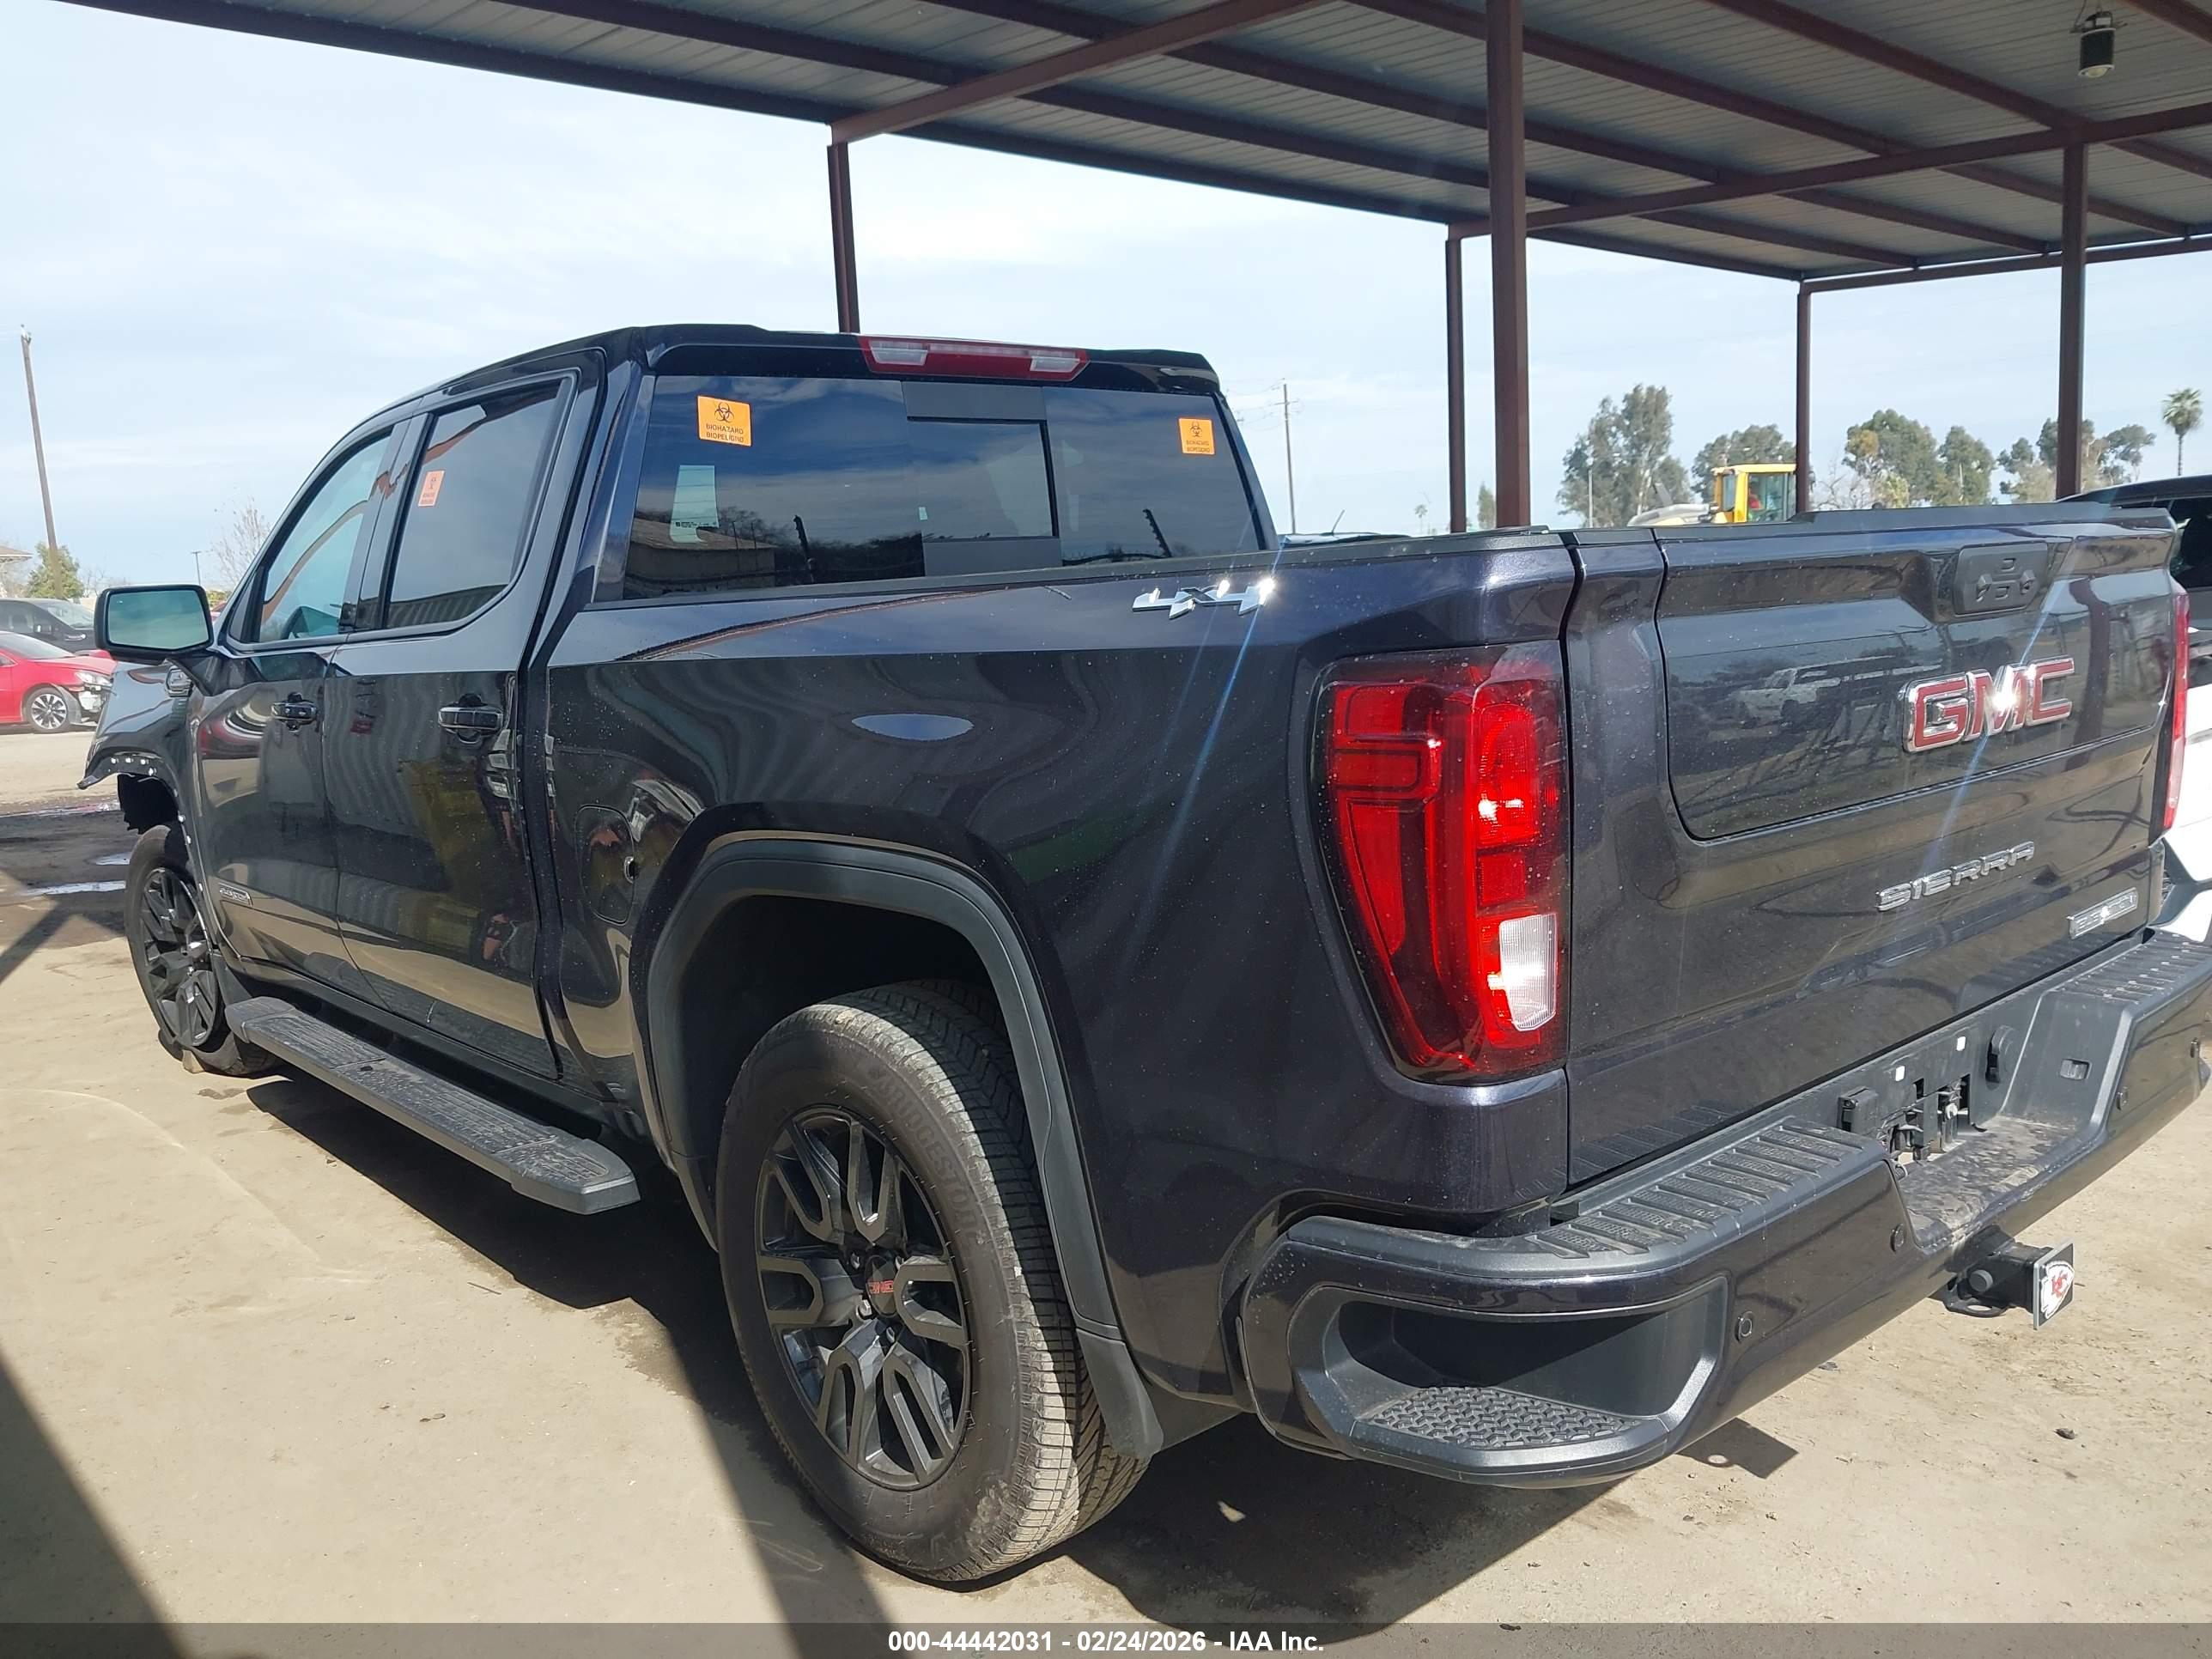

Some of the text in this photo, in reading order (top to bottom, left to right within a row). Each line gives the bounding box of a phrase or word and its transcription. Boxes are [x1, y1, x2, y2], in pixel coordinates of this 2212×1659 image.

[706, 422, 744, 434] BIOHAZARD
[1901, 655, 2075, 753] GMC
[1875, 841, 2035, 912] SIERRA
